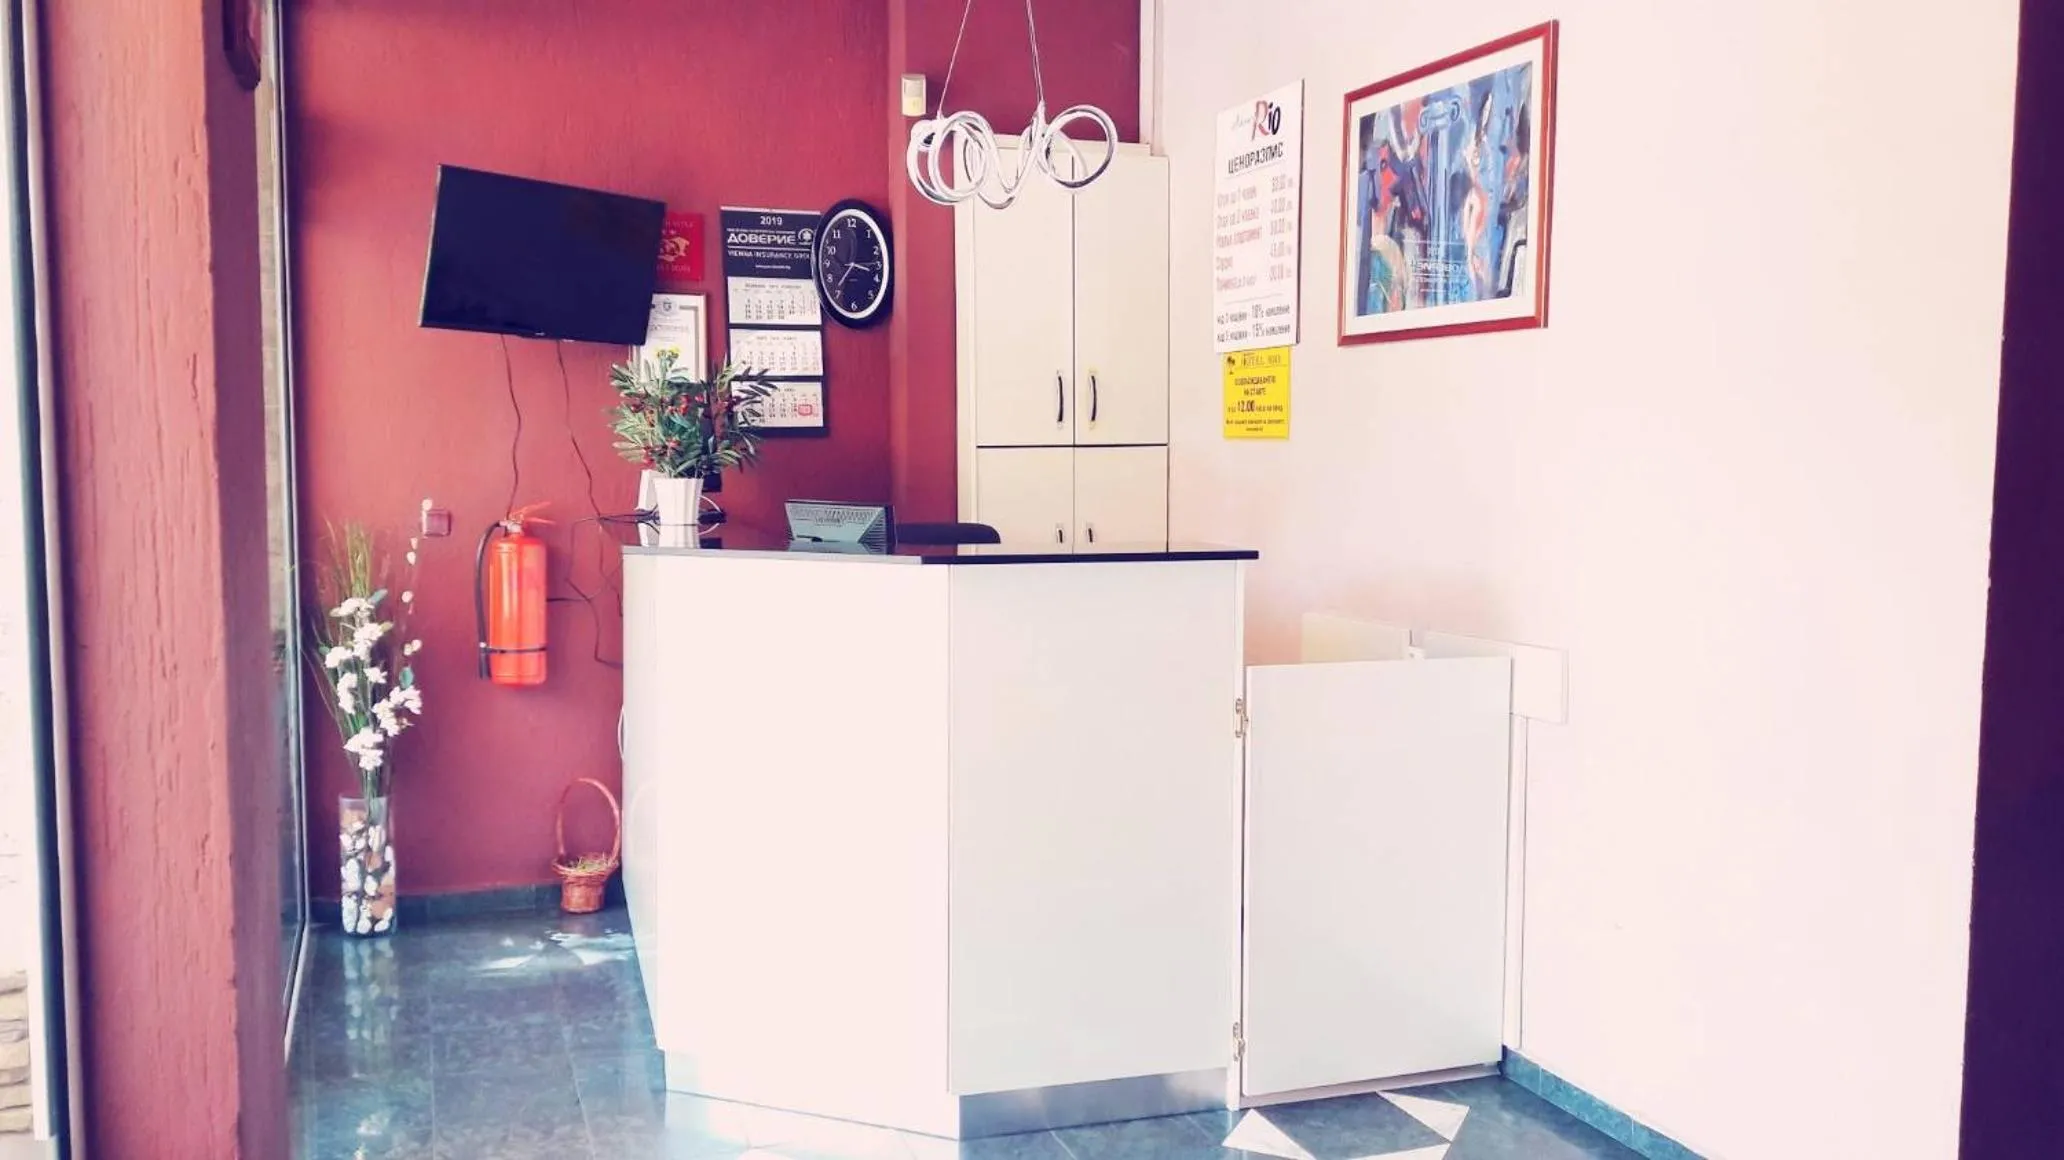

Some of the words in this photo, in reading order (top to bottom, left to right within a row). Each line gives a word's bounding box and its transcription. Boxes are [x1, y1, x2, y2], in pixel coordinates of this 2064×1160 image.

[1251, 100, 1281, 141] Rio
[1228, 142, 1284, 174] ЦЕНОРАЗПИС
[760, 216, 783, 226] 2019
[847, 218, 857, 228] 12
[727, 233, 796, 245] ДОВЕРИЕ
[832, 229, 841, 239] 11
[866, 229, 871, 239] 1
[827, 246, 836, 255] 10
[873, 246, 879, 255] 2
[824, 260, 831, 268] 9
[875, 261, 882, 270] 3
[826, 273, 833, 283] 8
[873, 274, 880, 283] 4
[835, 290, 841, 300] 7
[867, 290, 874, 300] 5
[851, 302, 858, 311] 6
[1238, 400, 1255, 412] 12.00
